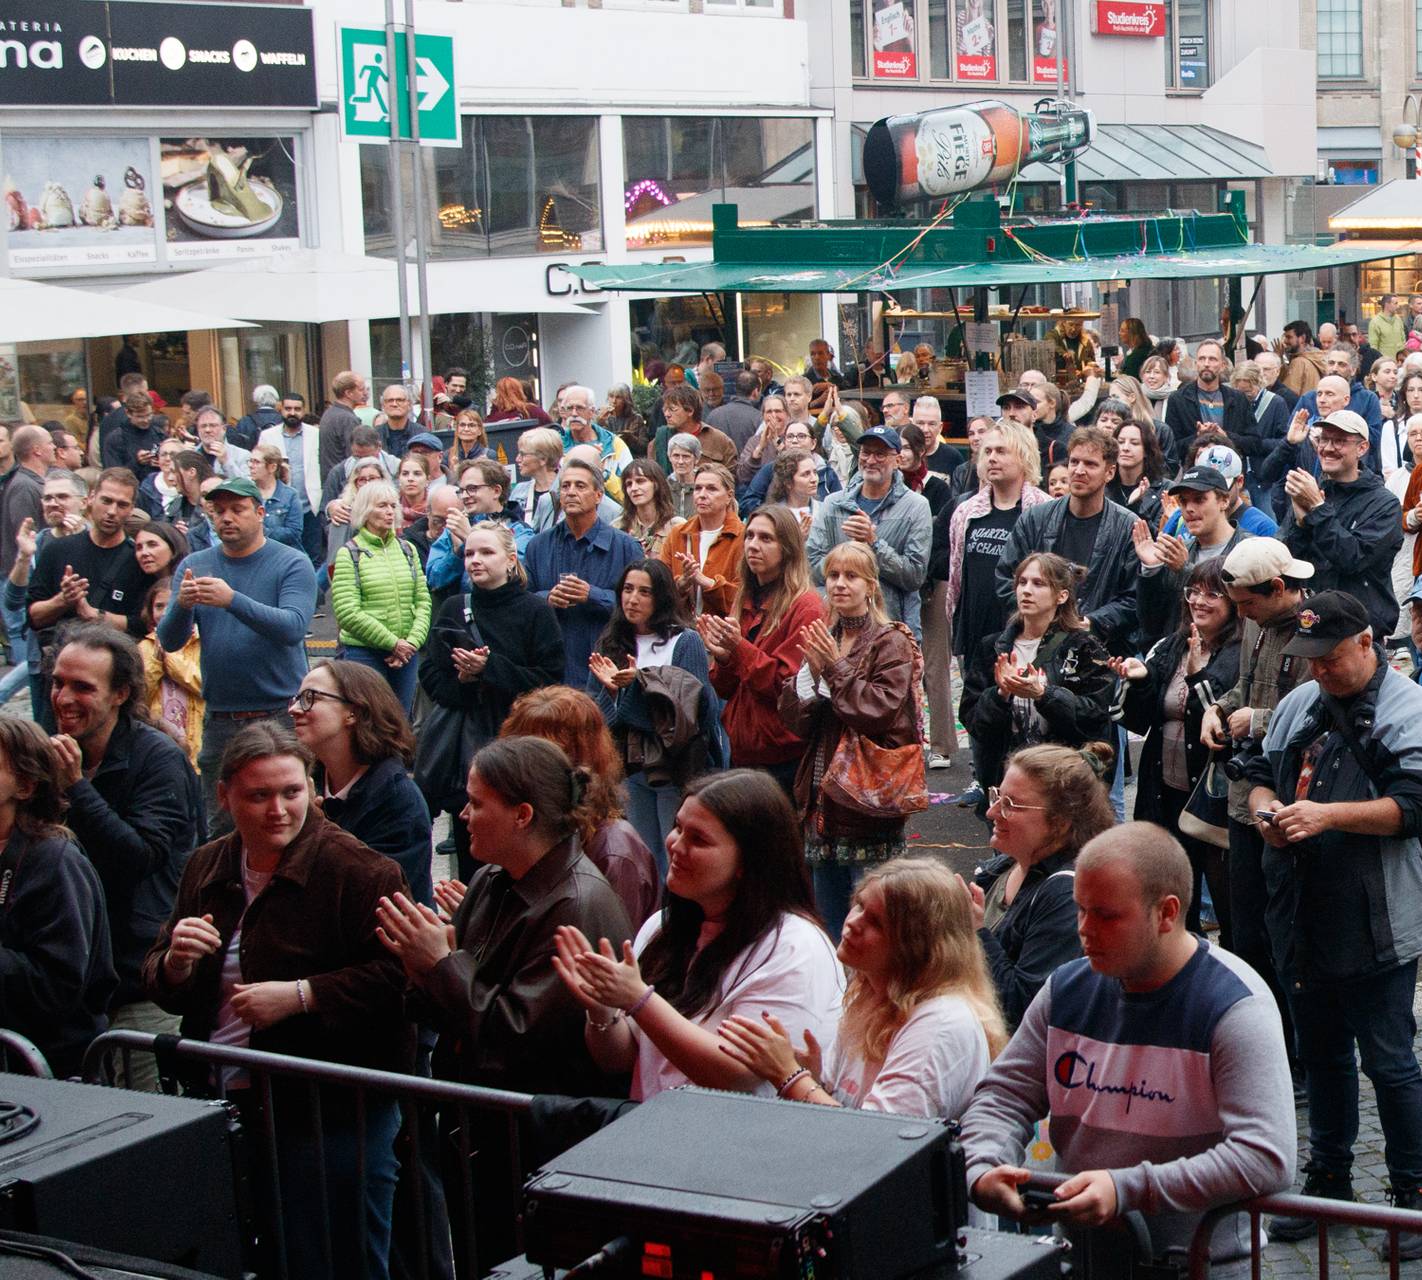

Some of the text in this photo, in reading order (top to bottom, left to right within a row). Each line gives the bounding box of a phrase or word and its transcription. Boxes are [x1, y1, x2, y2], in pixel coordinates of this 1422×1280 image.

[1107, 11, 1150, 26] Studienkreis
[112, 47, 306, 66] KUCHEN SNACKS WAFFELN
[932, 128, 952, 180] Pils
[949, 123, 968, 182] FIEGE
[1054, 1050, 1176, 1115] Champion
